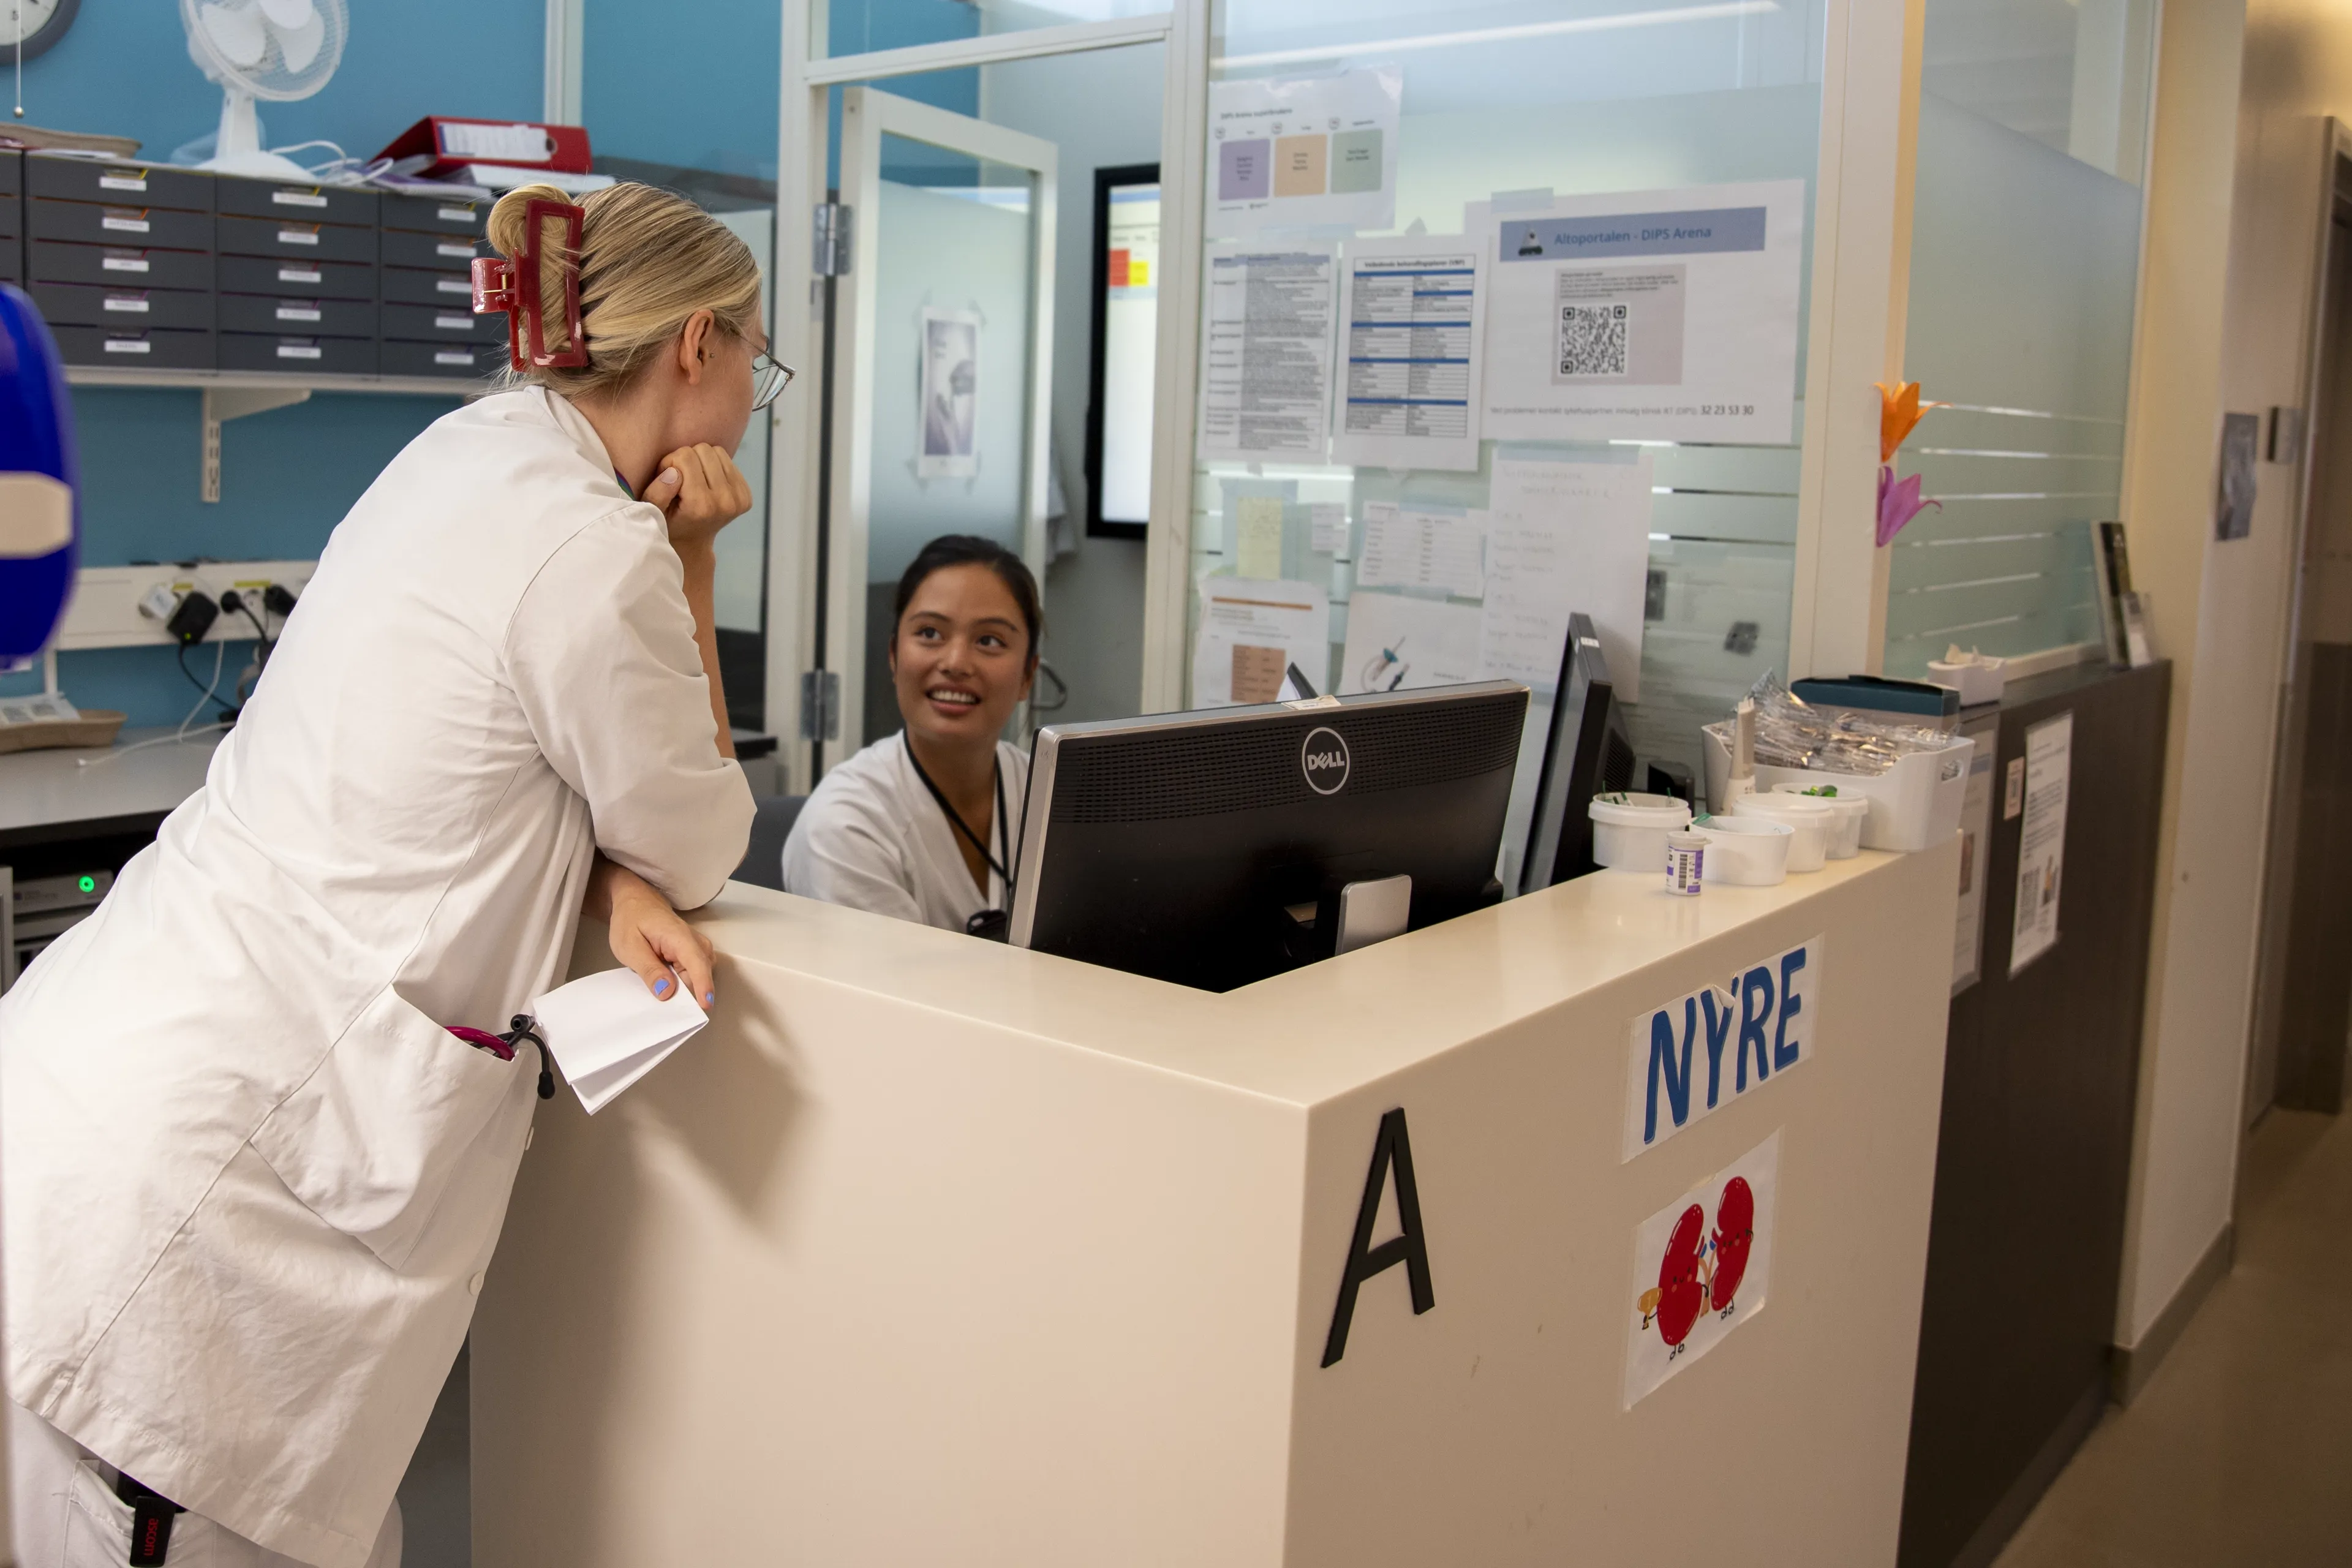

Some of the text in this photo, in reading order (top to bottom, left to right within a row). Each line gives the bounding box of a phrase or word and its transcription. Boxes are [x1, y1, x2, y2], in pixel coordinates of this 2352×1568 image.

[1555, 230, 1630, 246] Altoportalen
[1642, 228, 1669, 241] DIPS
[1673, 227, 1712, 239] Arena
[1700, 405, 1712, 415] 32
[1714, 405, 1725, 415] 23
[1728, 405, 1740, 415] 53
[1742, 405, 1754, 415] 30
[1307, 751, 1345, 771] DELL
[1644, 947, 1806, 1144] NYRE
[1320, 1107, 1435, 1369] A
[144, 1518, 159, 1556] ascom
